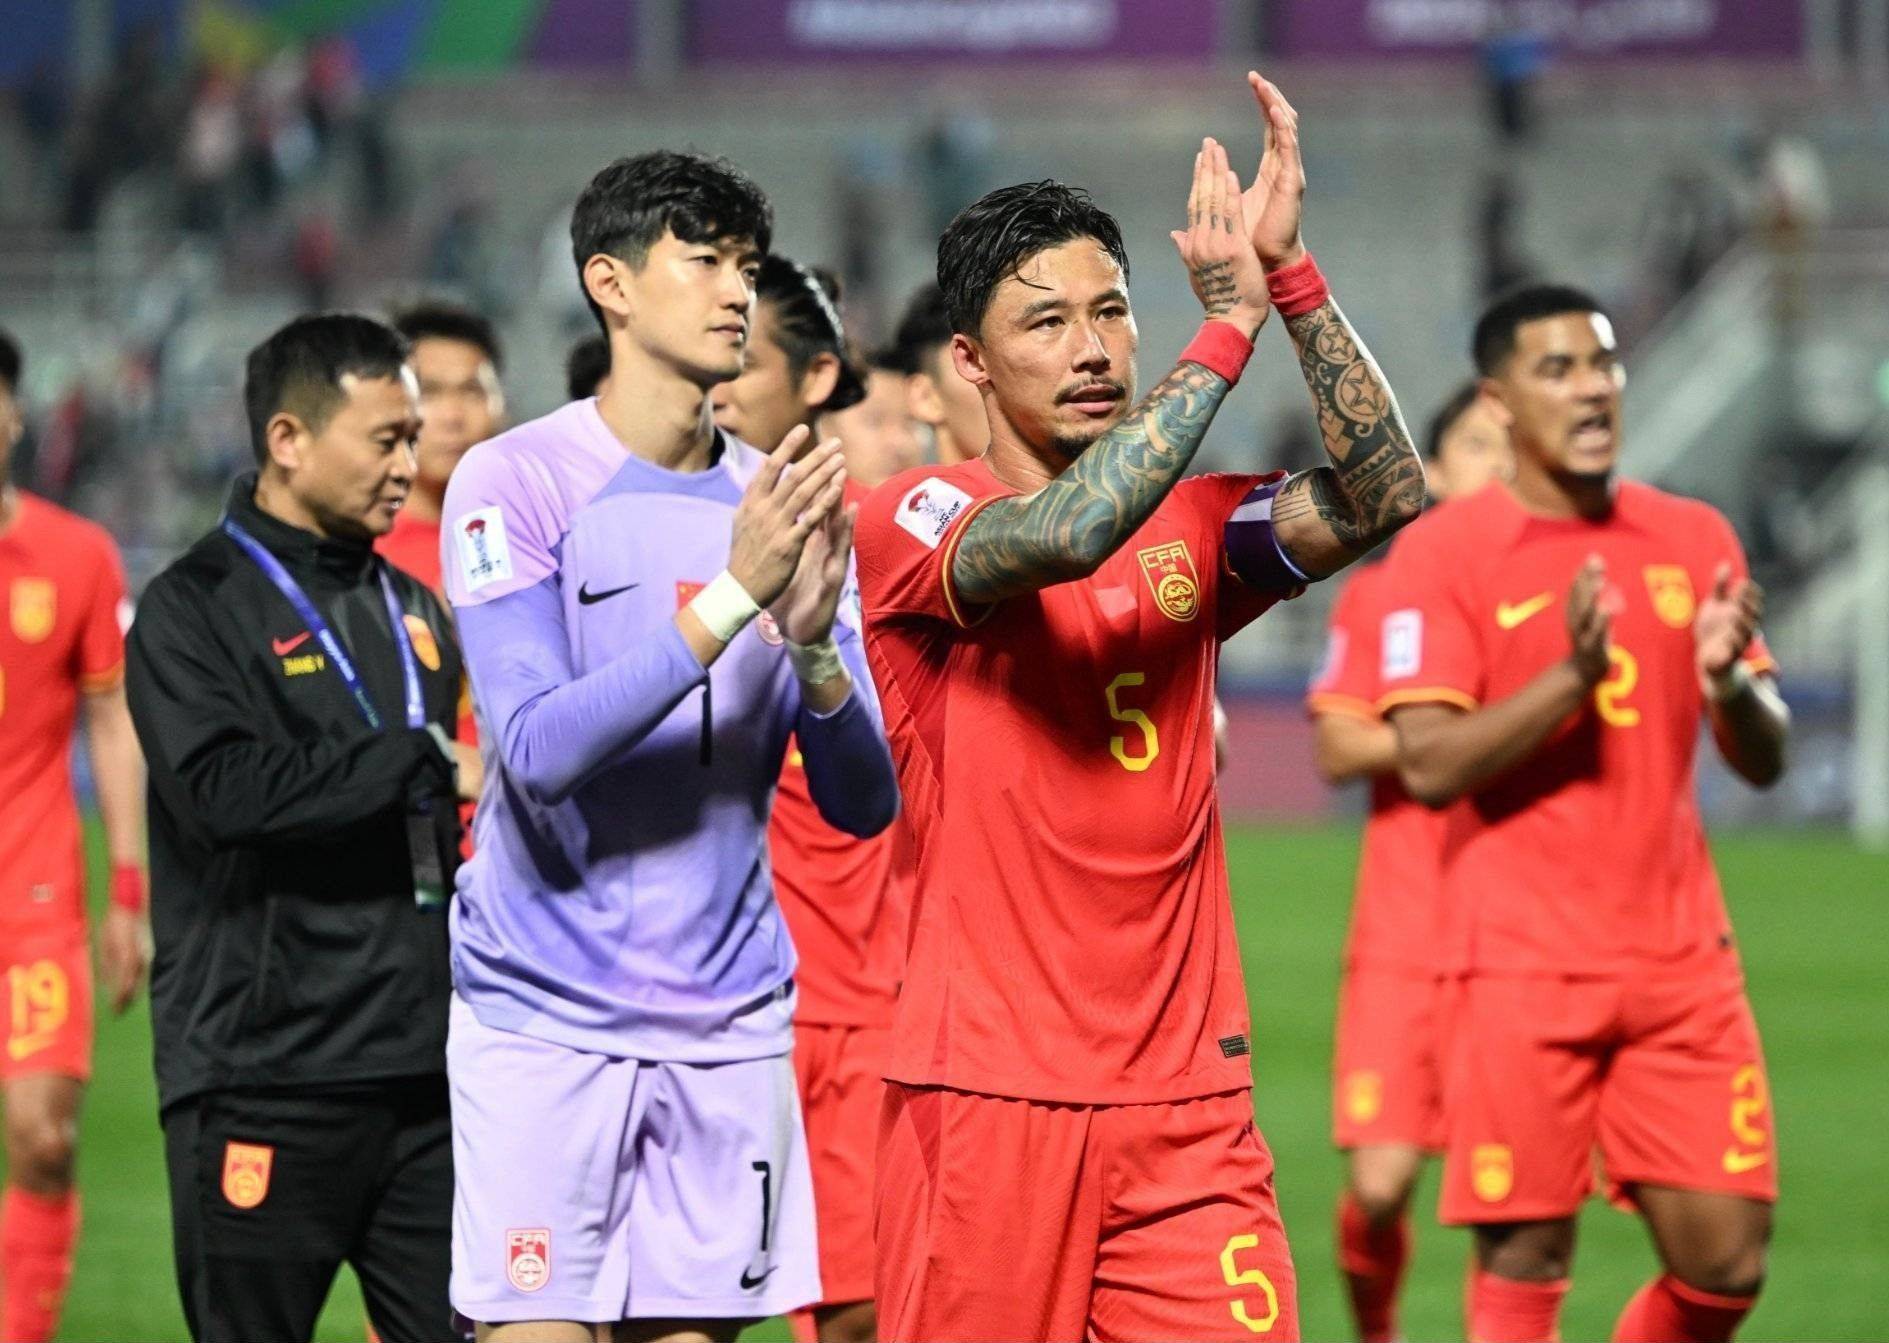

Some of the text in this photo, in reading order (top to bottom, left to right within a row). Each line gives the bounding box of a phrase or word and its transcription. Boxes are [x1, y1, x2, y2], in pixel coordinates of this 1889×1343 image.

[934, 515, 949, 535] ASIAN
[948, 501, 959, 516] CUP
[1142, 546, 1186, 568] CFA
[1105, 672, 1159, 772] 5
[1595, 645, 1641, 727] 2
[9, 960, 69, 1032] 19
[1731, 1064, 1767, 1145] 2
[752, 1161, 770, 1251] 1
[1220, 1234, 1279, 1332] 5
